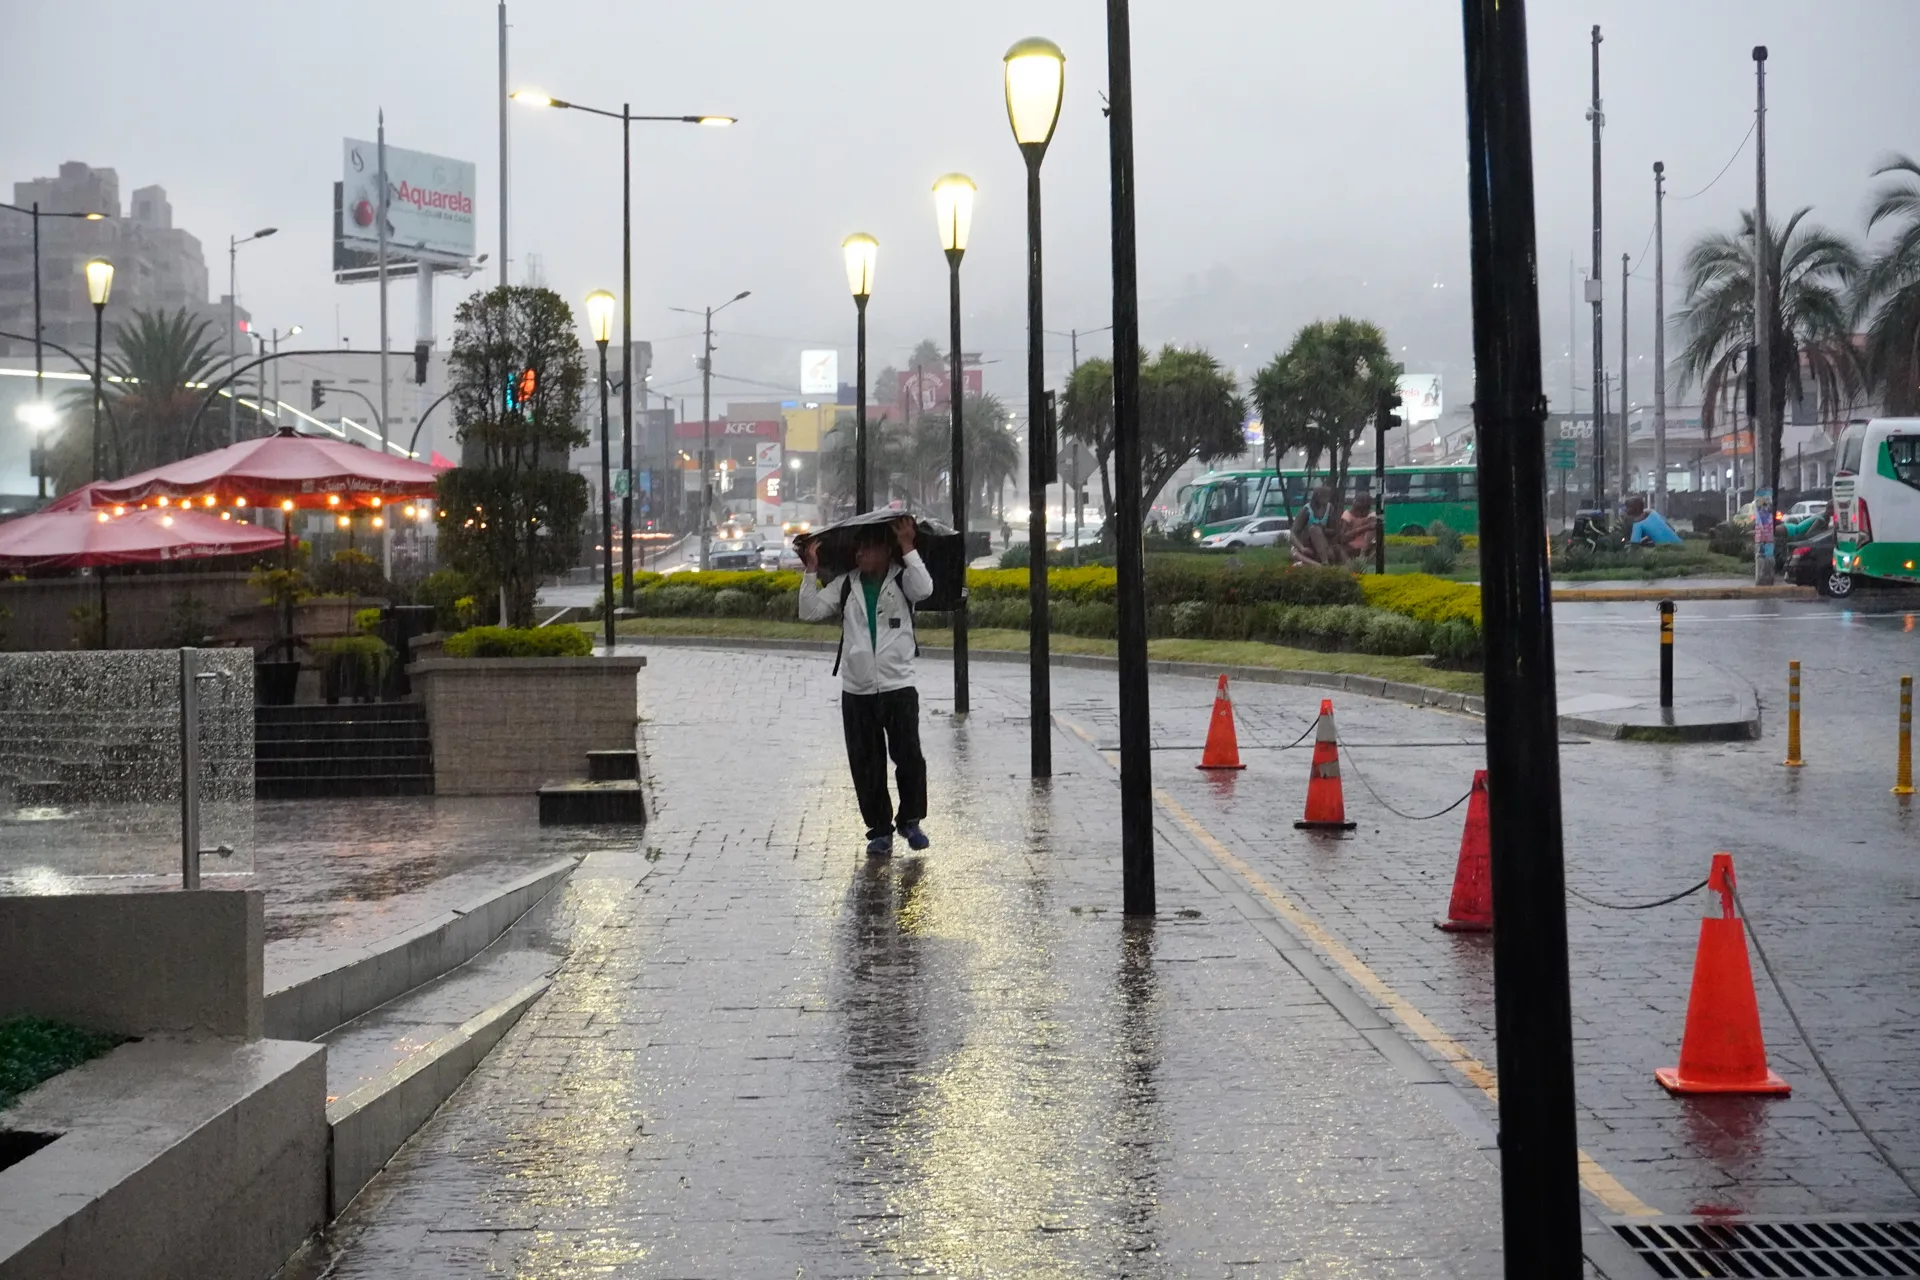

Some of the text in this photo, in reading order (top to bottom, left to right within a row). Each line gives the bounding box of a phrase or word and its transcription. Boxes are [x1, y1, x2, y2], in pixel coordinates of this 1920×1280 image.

[399, 179, 472, 214] Aquarela
[724, 422, 756, 434] KFC
[1560, 420, 1594, 430] PLAZ
